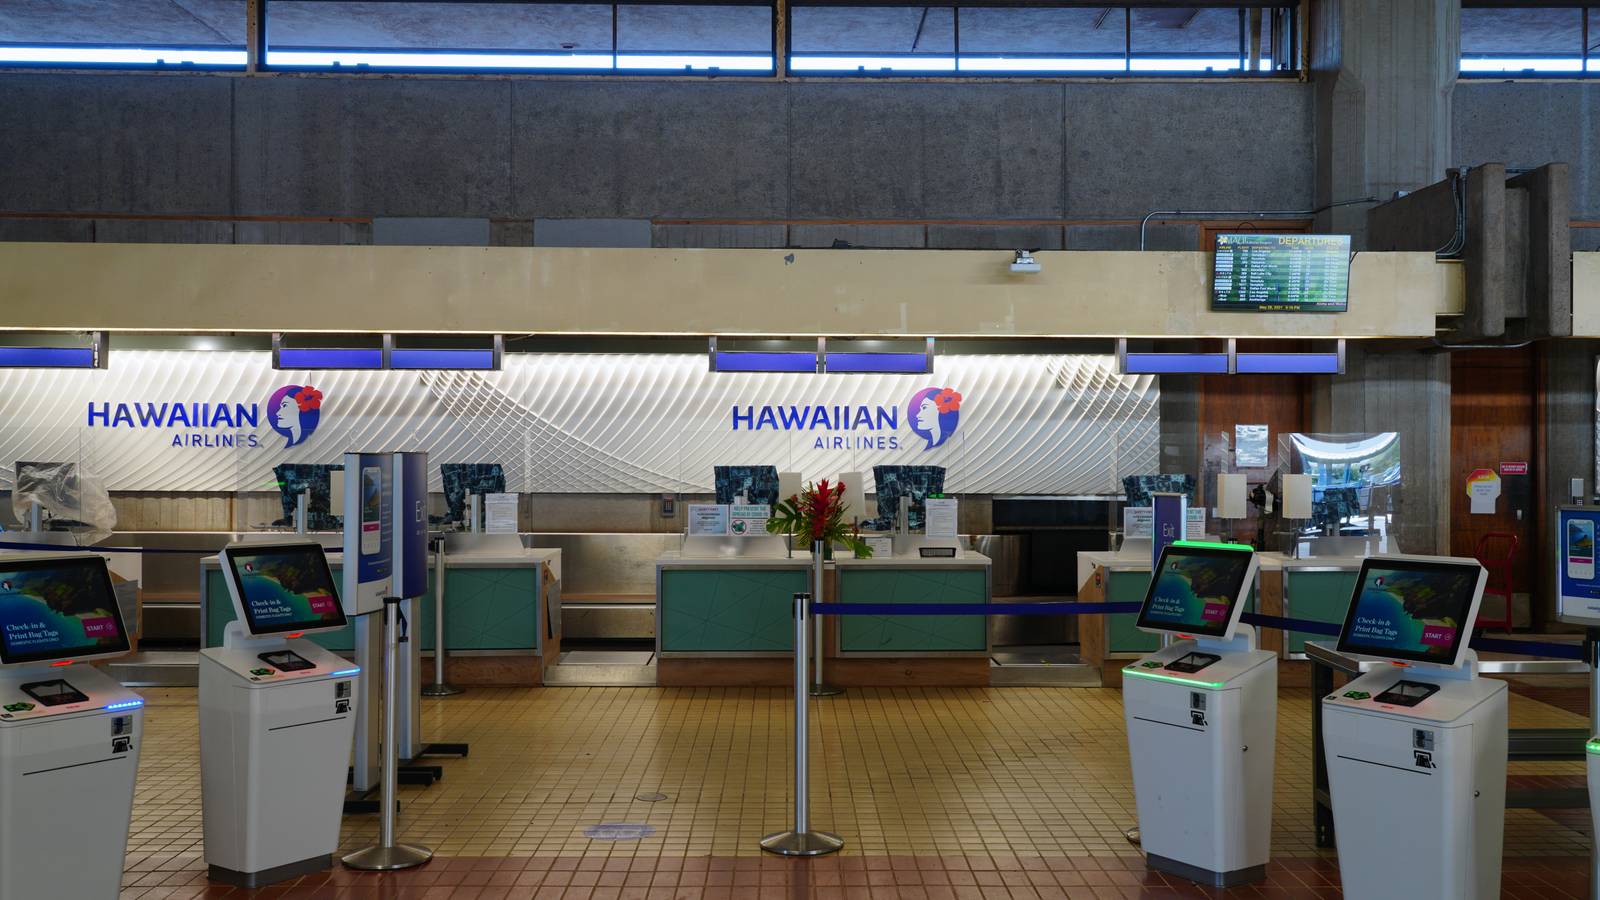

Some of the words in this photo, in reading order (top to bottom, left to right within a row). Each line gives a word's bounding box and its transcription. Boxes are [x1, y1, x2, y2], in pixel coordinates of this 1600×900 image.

[1279, 237, 1344, 246] DEPARTURES
[88, 402, 258, 427] HAWAIIAN
[732, 406, 898, 430] HAWAIIAN
[172, 434, 258, 448] AIRLINES
[814, 436, 898, 450] AIRLINES
[1162, 523, 1175, 537] Exit
[6, 623, 38, 632] Check-in
[1358, 617, 1384, 625] Check-in
[8, 632, 28, 640] Print
